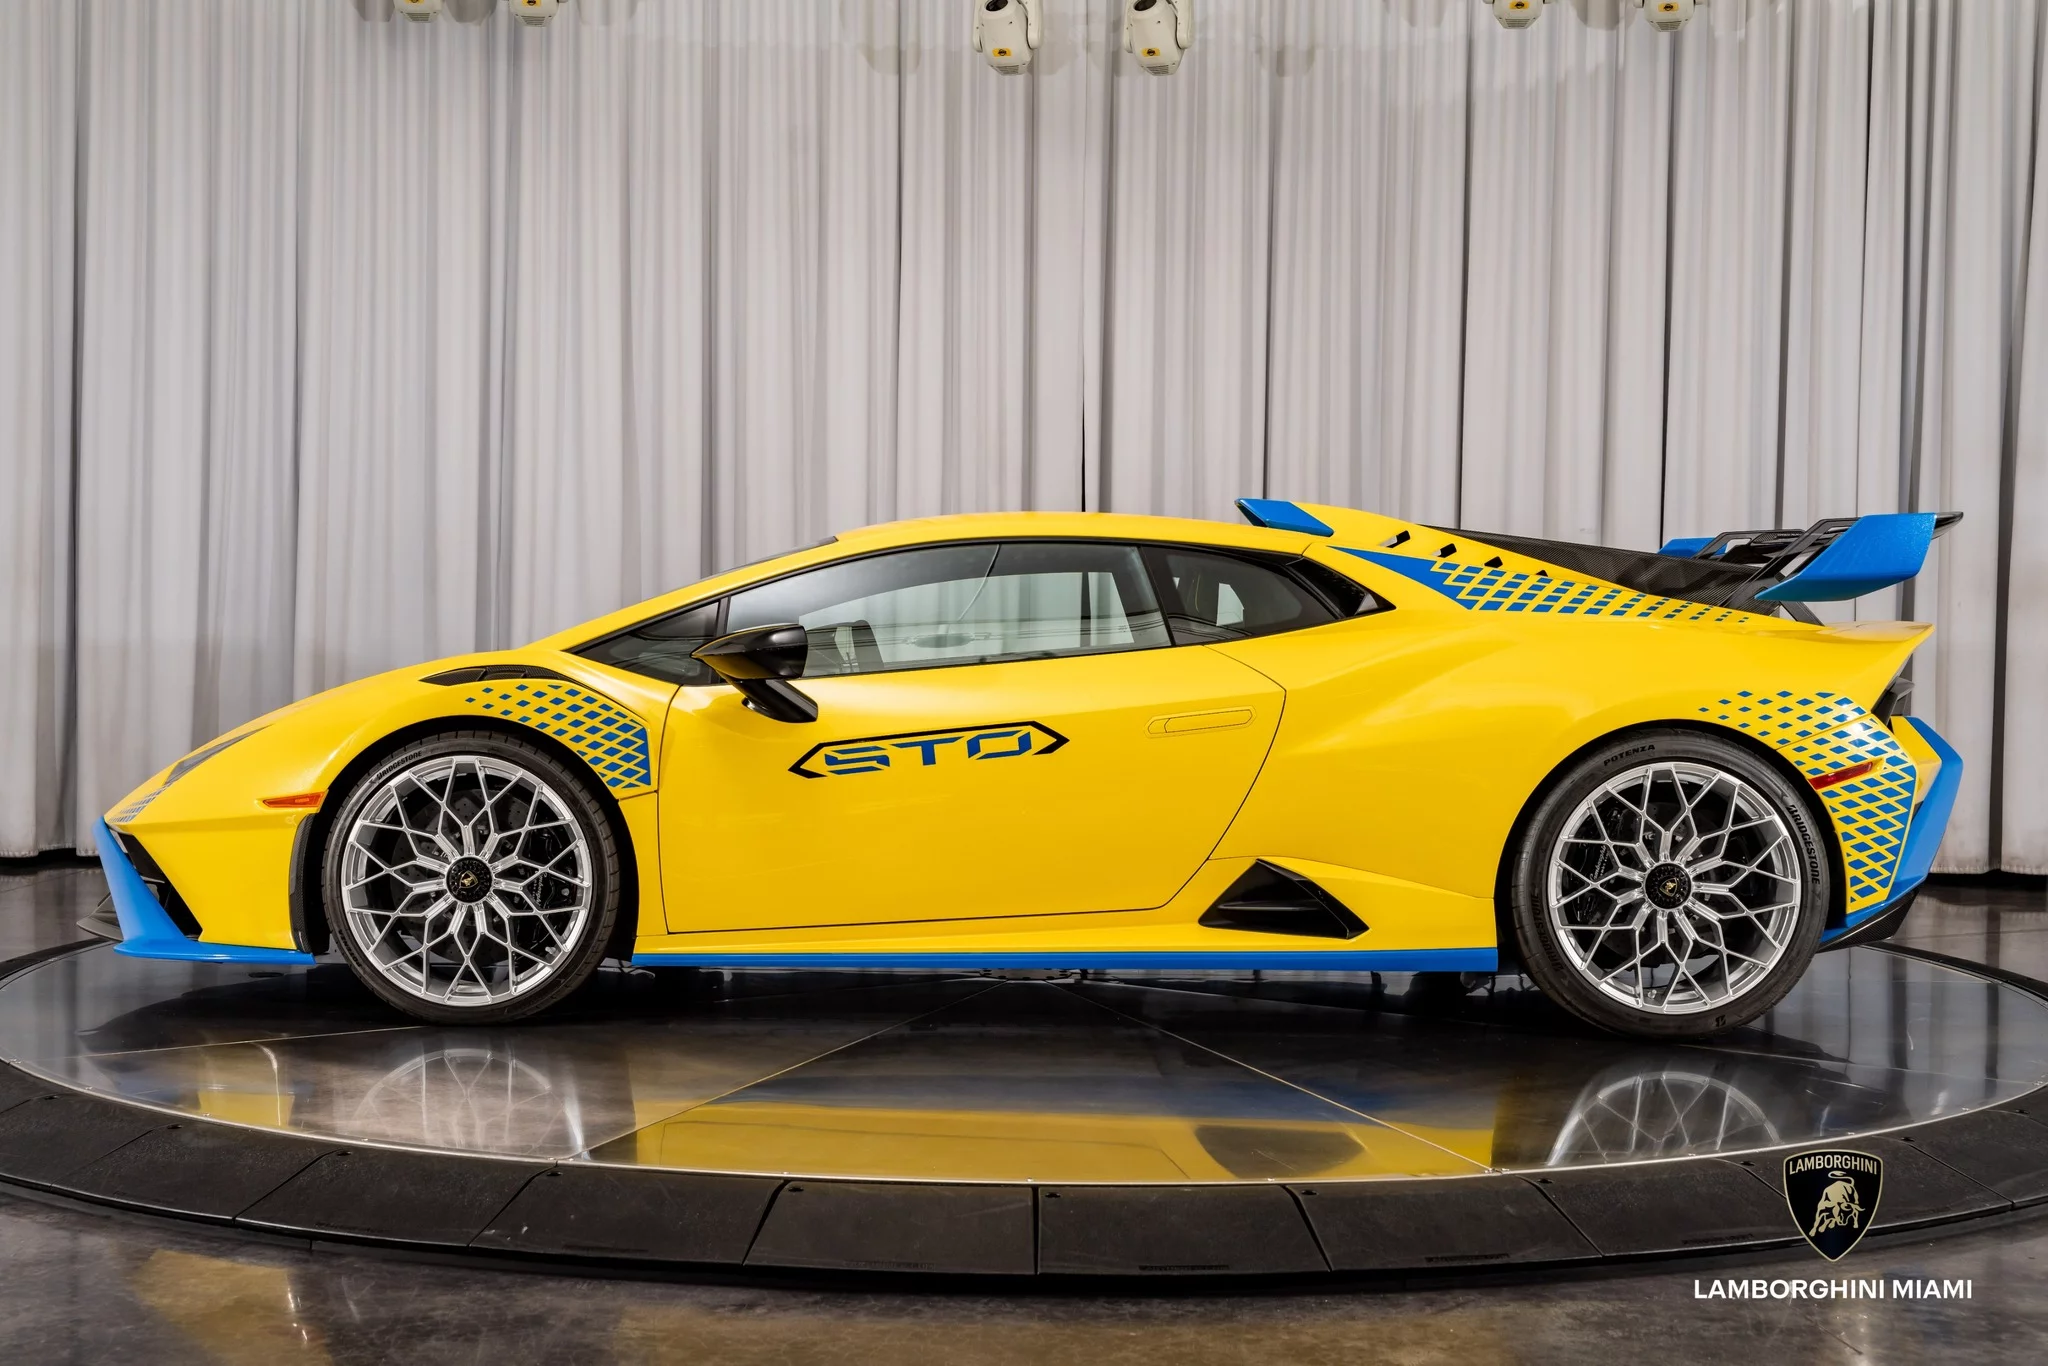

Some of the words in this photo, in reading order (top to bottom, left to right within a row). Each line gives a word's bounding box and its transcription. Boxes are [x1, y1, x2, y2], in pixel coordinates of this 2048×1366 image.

[376, 750, 422, 780] BRIDGESTONE
[824, 729, 1032, 776] STO
[1603, 744, 1656, 767] POTENZA
[1786, 804, 1821, 885] BRIDGESTONE
